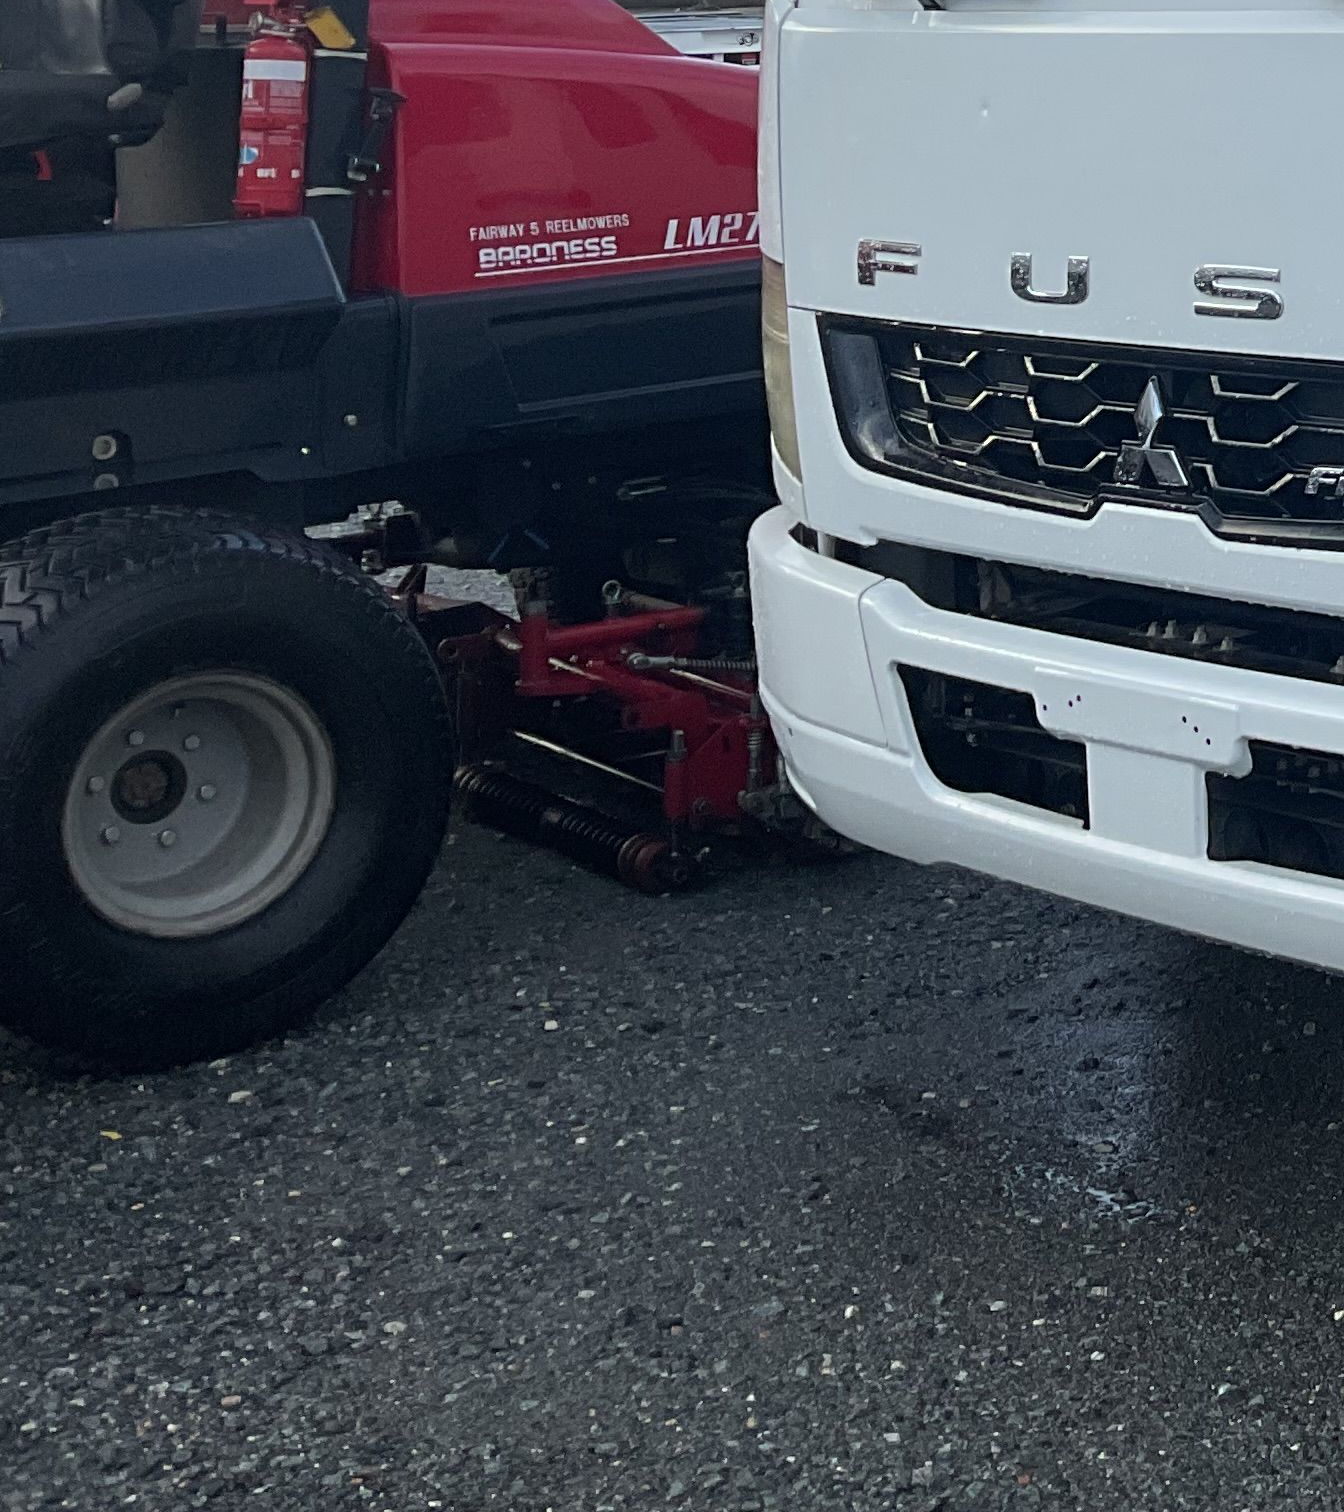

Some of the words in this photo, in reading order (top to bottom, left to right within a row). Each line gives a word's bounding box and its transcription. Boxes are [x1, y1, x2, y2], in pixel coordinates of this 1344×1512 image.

[469, 223, 526, 242] FAIRWAY
[545, 213, 631, 234] REELMOWERS
[663, 211, 760, 250] LM27
[478, 235, 618, 270] BARONESS
